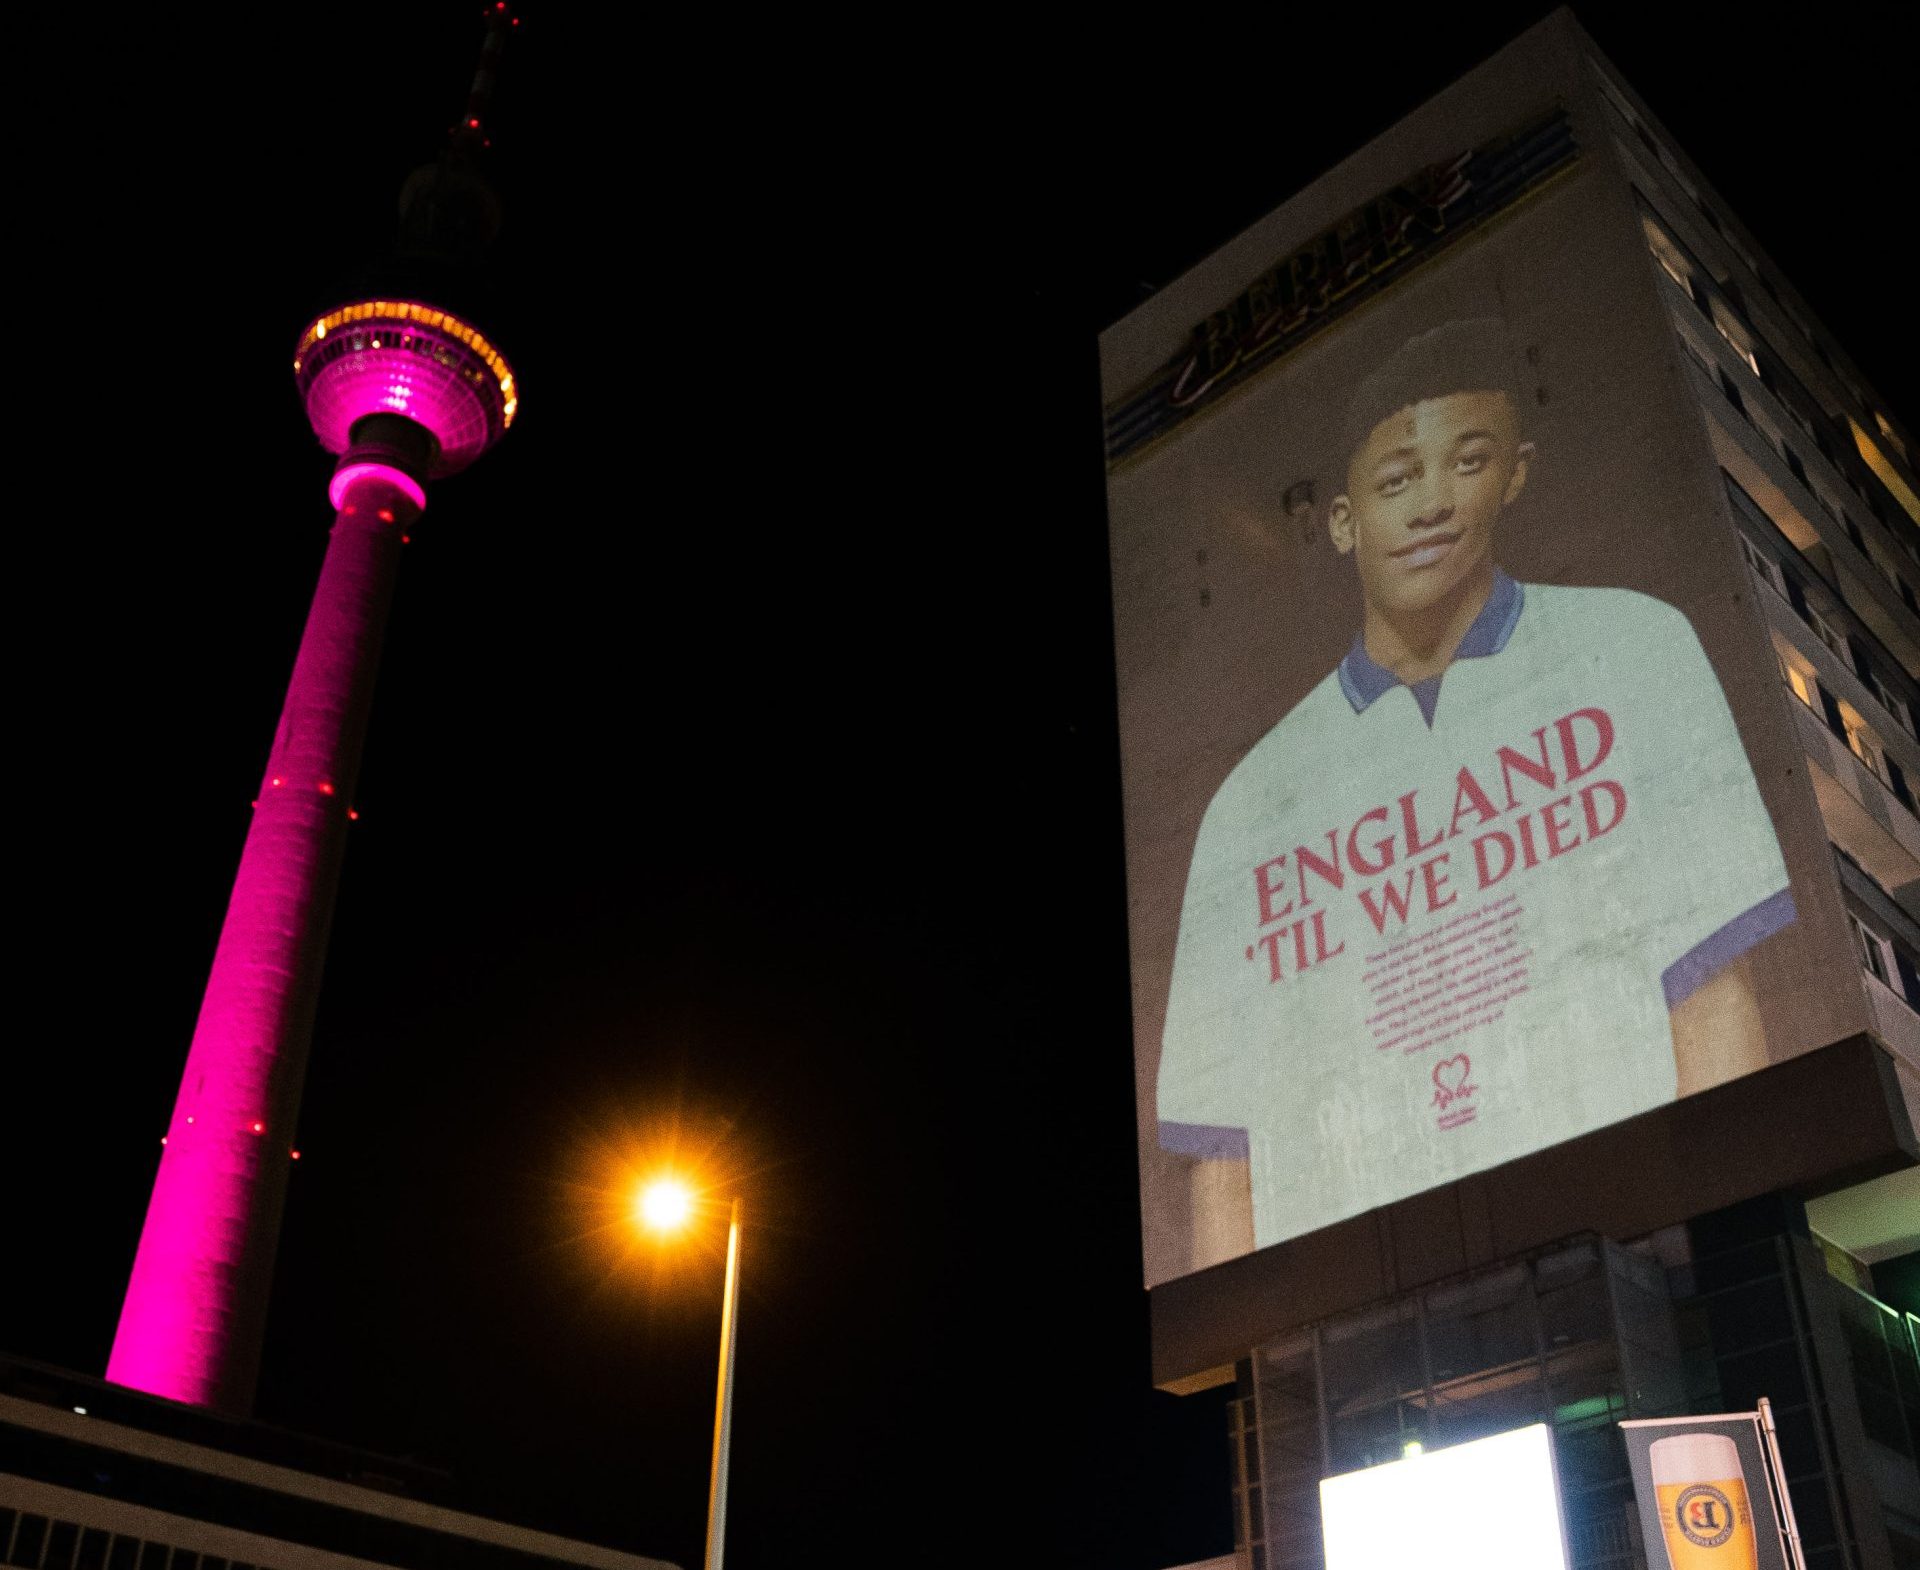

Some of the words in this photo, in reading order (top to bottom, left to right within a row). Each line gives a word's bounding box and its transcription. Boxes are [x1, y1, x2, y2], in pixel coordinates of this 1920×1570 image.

[1253, 706, 1615, 928] ENGLAND
[1357, 851, 1458, 937] WE
[1470, 778, 1628, 891] DIED
